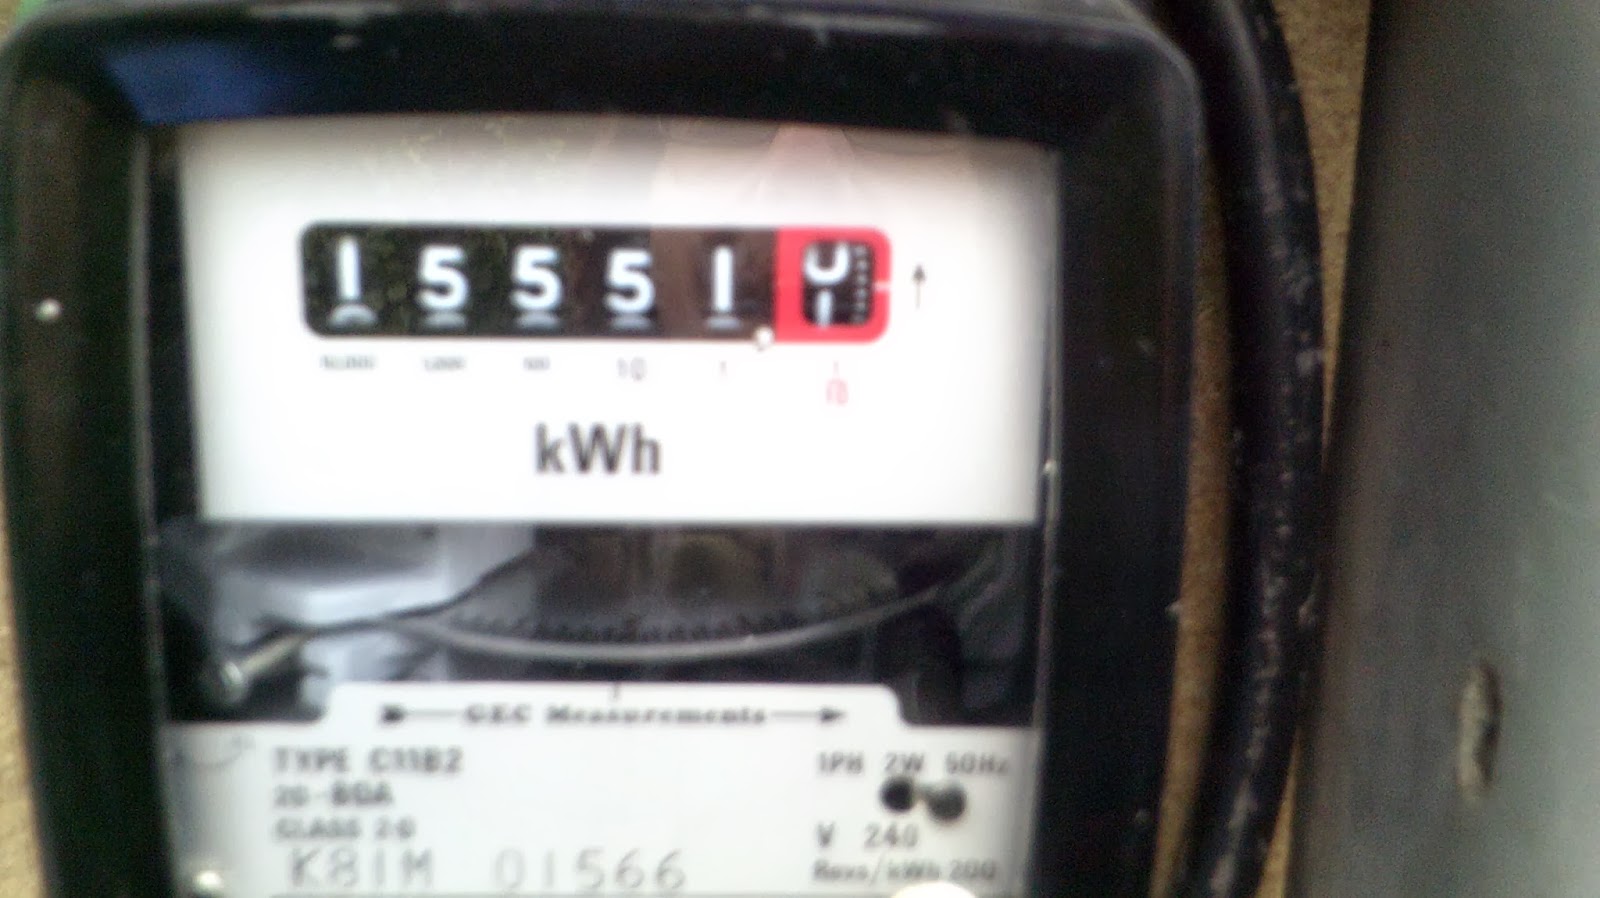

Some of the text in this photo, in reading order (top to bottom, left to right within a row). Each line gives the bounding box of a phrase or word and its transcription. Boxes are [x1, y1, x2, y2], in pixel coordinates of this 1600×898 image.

[534, 424, 662, 475] kWh
[544, 705, 766, 725] Measurements
[274, 746, 350, 773] TYPE
[274, 817, 361, 839] CLASS
[863, 823, 919, 849] 240
